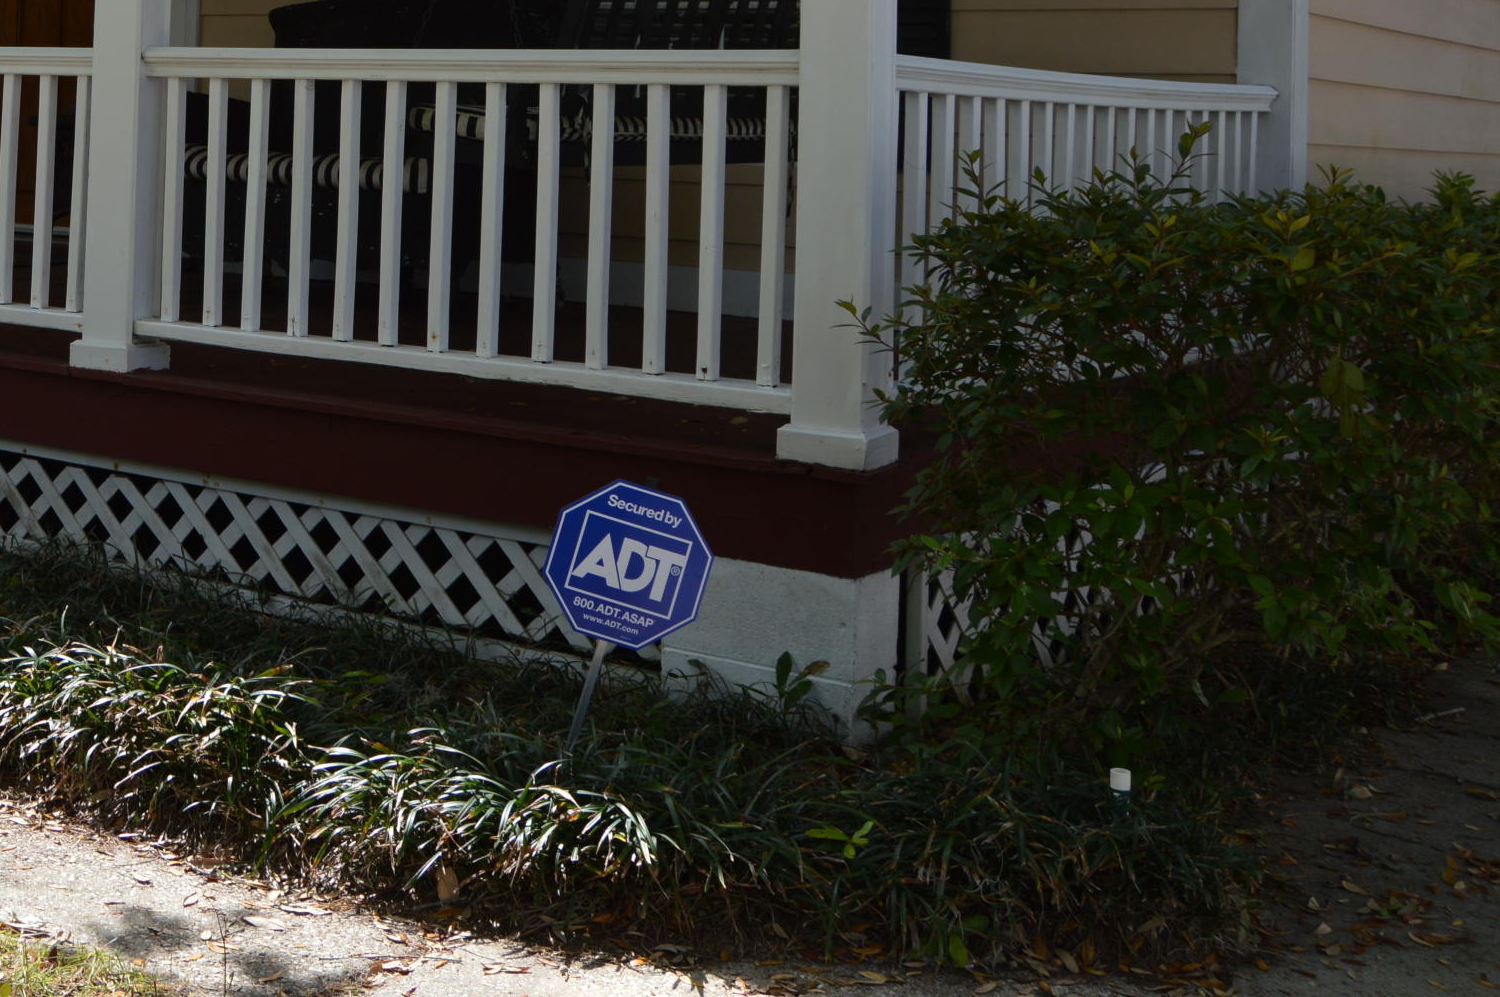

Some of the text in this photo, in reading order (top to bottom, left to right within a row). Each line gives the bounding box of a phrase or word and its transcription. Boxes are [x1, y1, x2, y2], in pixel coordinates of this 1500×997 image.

[607, 494, 682, 529] Secured by
[583, 612, 639, 635] www.ADT.com
